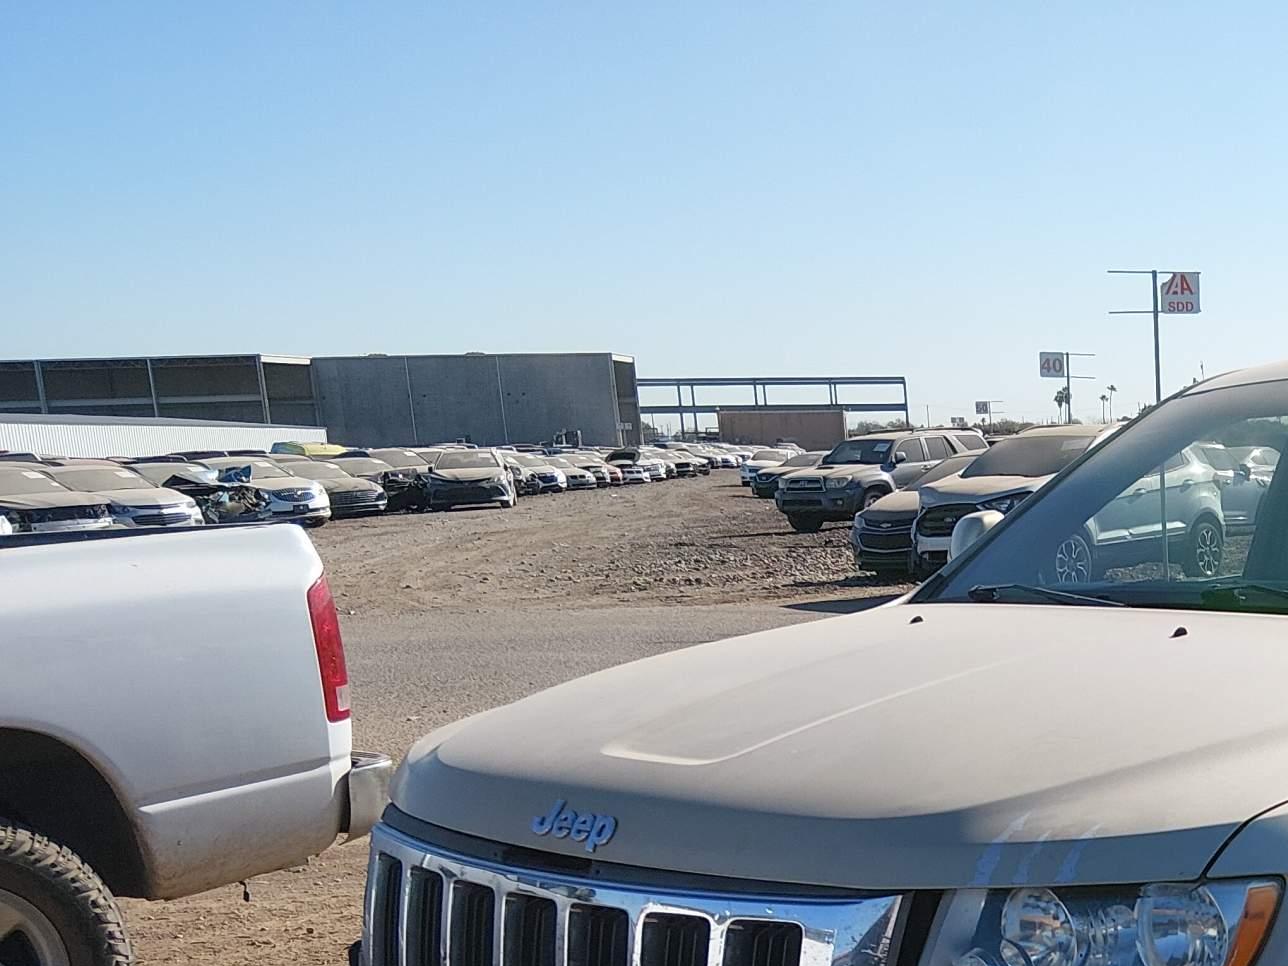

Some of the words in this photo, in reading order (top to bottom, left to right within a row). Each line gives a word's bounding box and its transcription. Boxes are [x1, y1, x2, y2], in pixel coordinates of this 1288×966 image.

[1168, 301, 1194, 312] SDD
[1041, 358, 1064, 373] 40
[530, 799, 618, 853] Jeep
